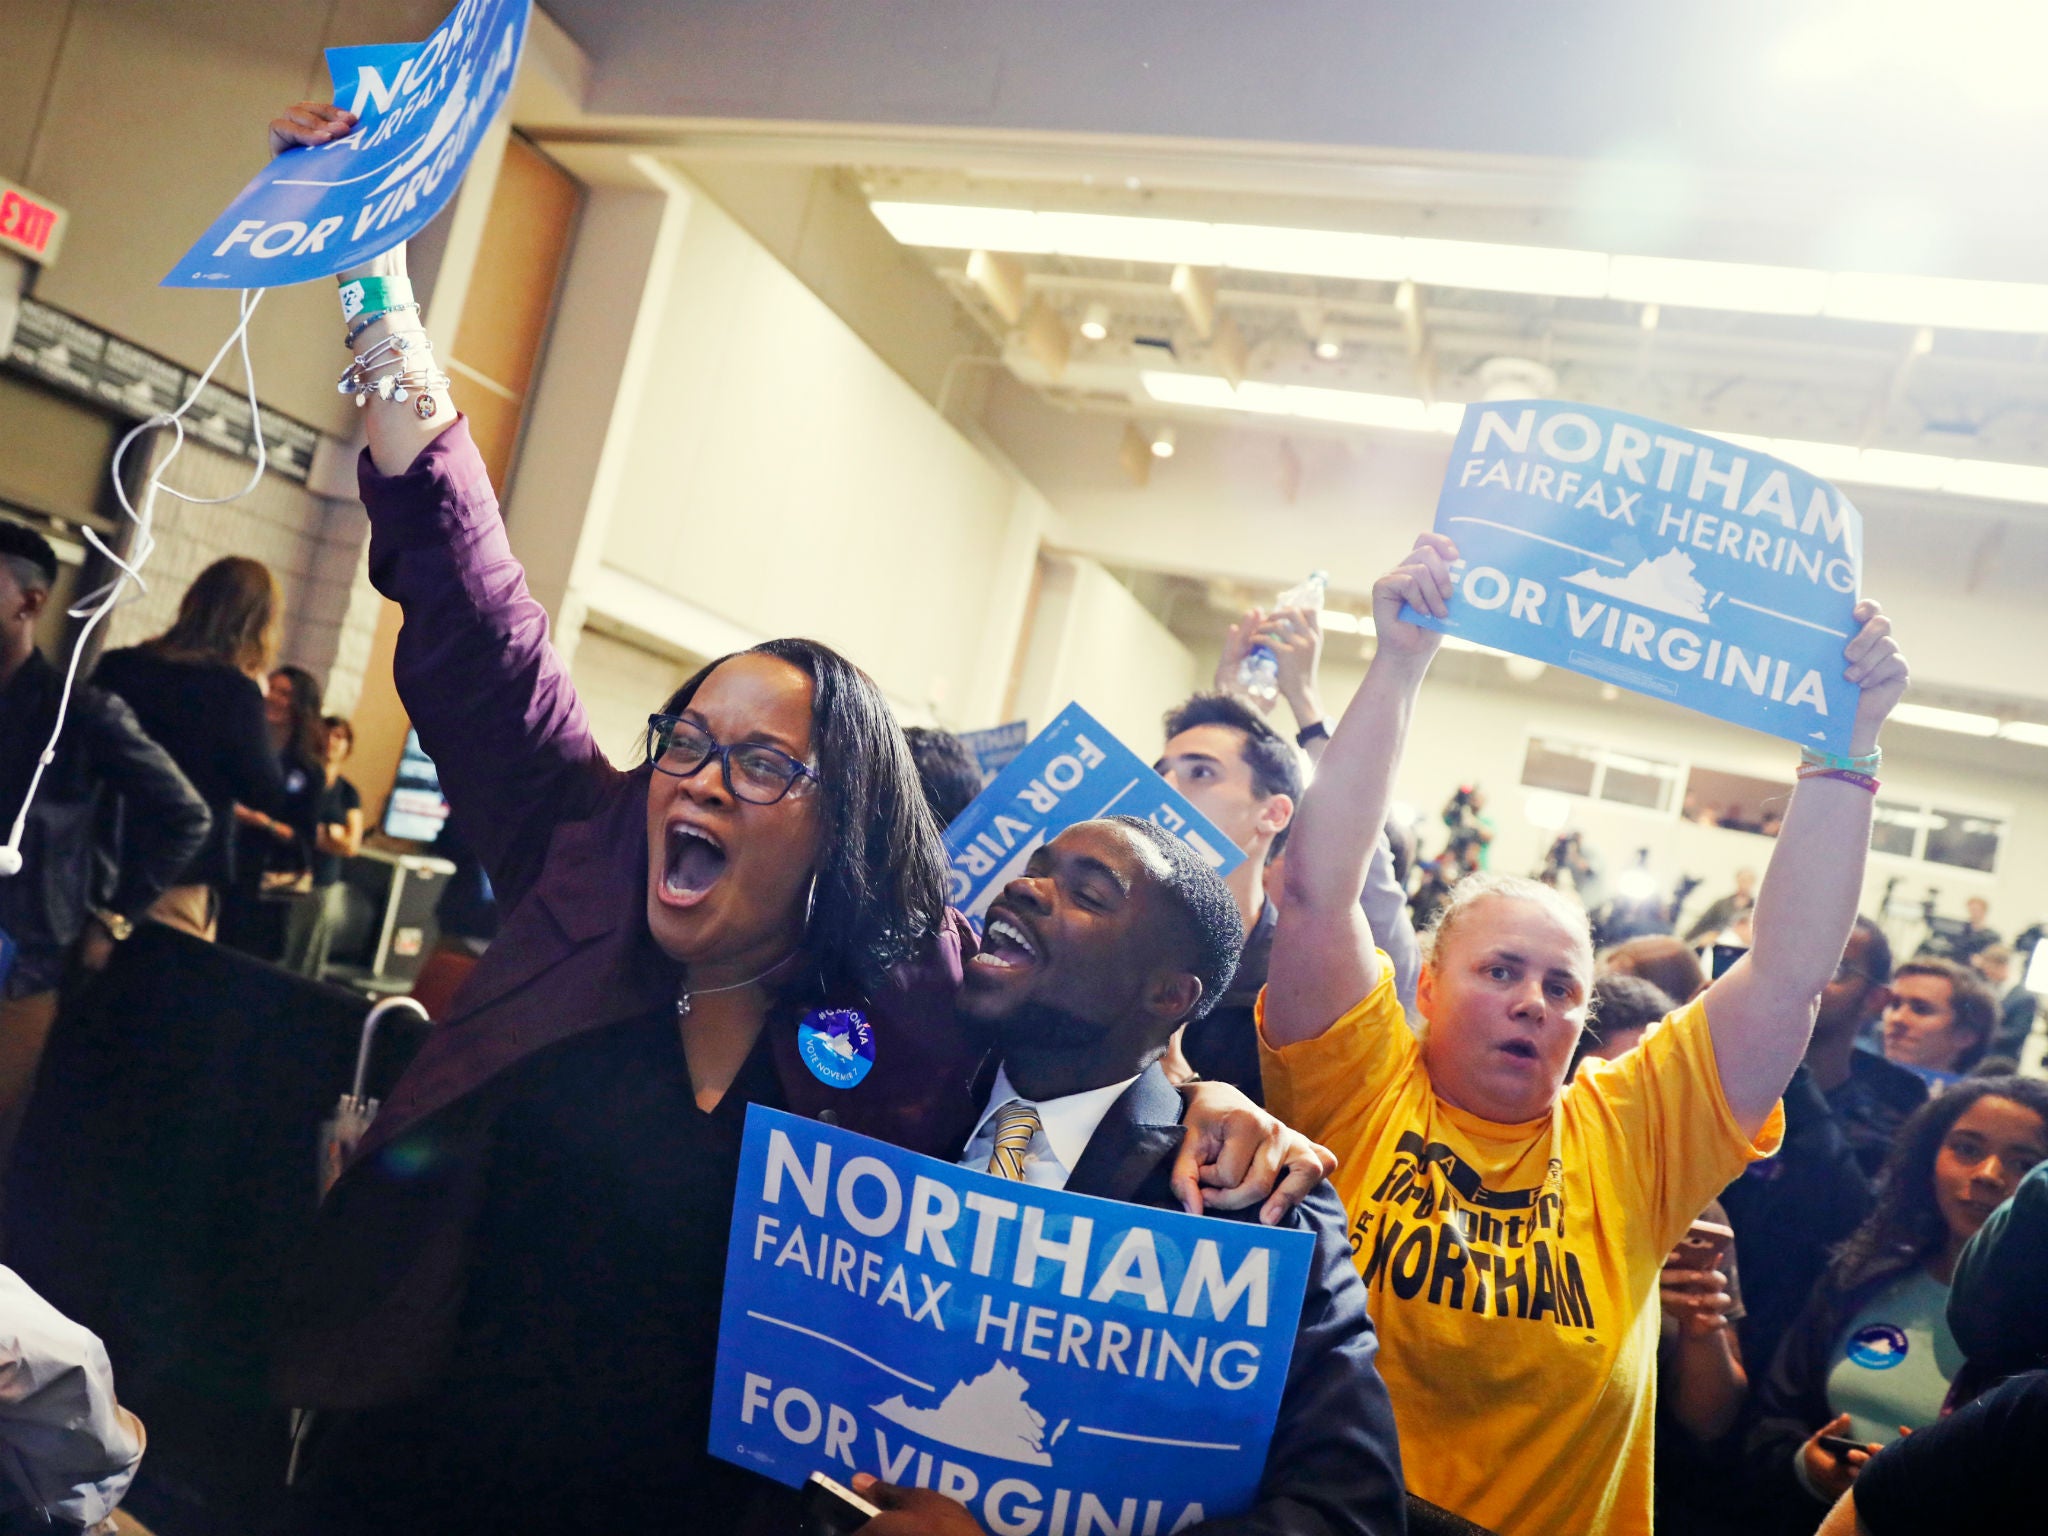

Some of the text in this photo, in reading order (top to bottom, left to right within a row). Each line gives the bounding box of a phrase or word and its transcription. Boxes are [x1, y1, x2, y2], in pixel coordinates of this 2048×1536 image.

[307, 50, 457, 151] AIRFAX
[0, 189, 58, 254] EXIT
[212, 215, 345, 258] FOR
[1459, 458, 1856, 594] FAIRFAX HERRING
[1471, 409, 1855, 559] NORTHAM
[1565, 592, 1829, 717] VIRGINIA
[1017, 733, 1107, 814] FOR
[806, 1039, 819, 1064] VOTE
[762, 1128, 1270, 1328] NORTHAM
[1361, 1212, 1595, 1329] NORTHAM
[753, 1214, 1261, 1391] FAIRFAX HERRING
[739, 1371, 858, 1470] FOR
